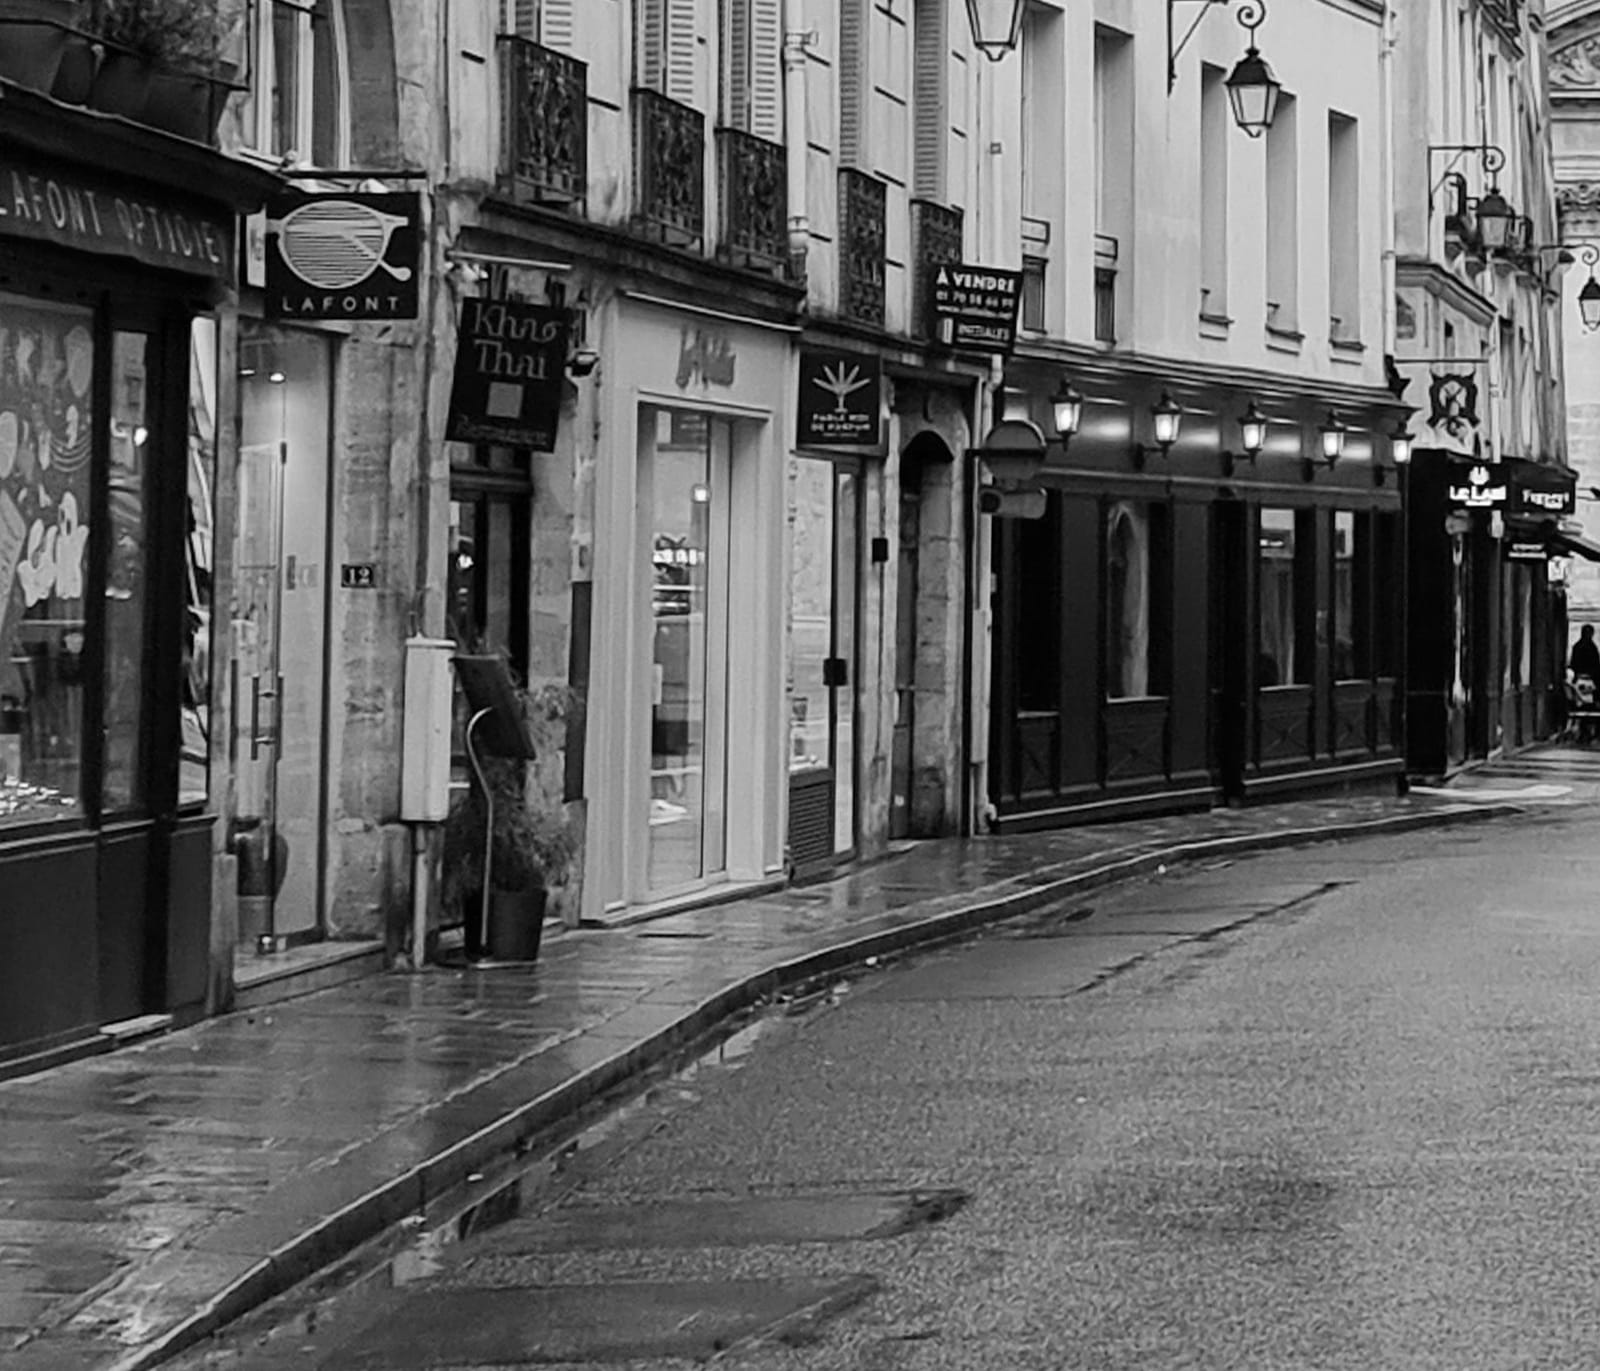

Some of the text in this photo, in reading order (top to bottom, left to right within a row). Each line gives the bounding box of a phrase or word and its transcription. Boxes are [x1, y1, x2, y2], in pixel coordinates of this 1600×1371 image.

[0, 171, 101, 236] AFONT
[953, 271, 1014, 293] VENDRE
[282, 296, 398, 312] LAFONT
[473, 338, 549, 380] Thai
[350, 567, 371, 585] 12
